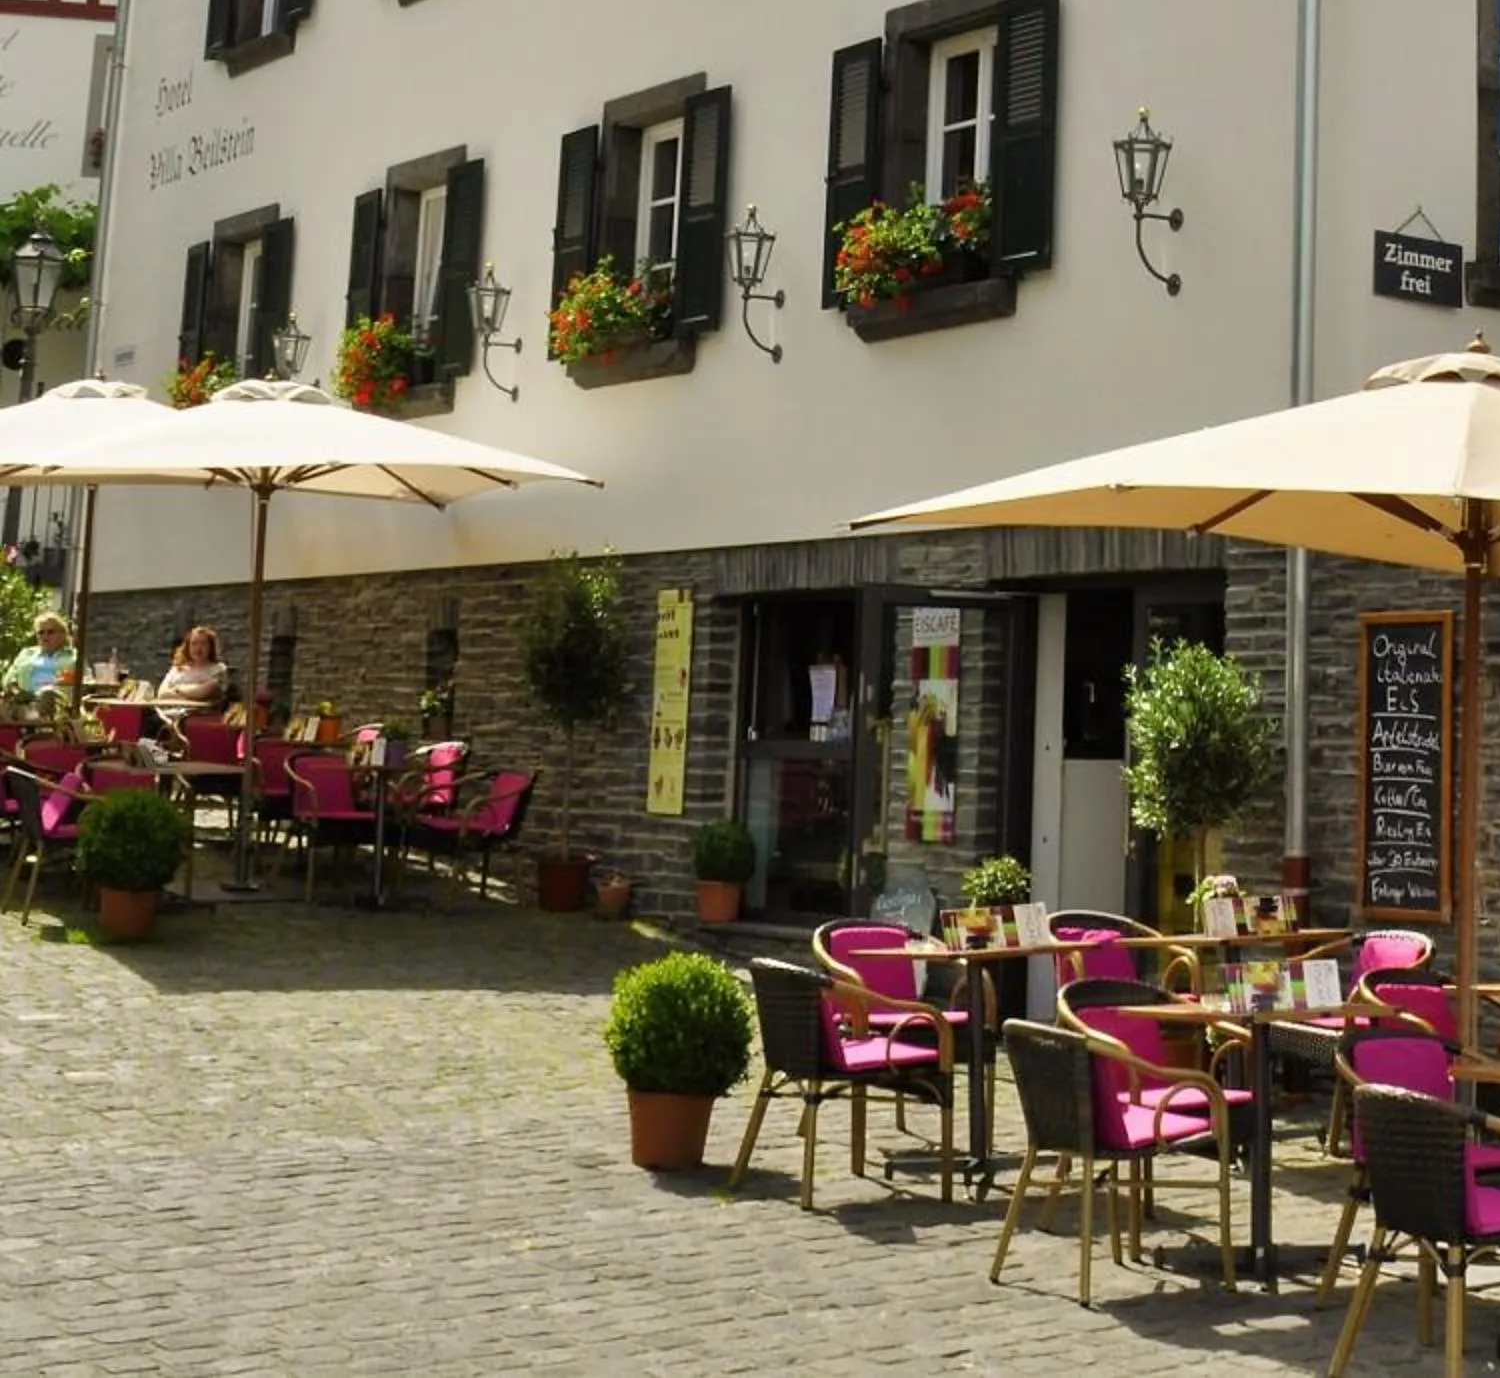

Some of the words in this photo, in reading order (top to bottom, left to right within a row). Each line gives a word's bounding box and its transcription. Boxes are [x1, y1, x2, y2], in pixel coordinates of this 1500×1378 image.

[154, 60, 194, 118] Hotel
[149, 144, 183, 190] Villa
[187, 116, 256, 176] Beilstein
[1384, 242, 1453, 273] Zimmer
[1400, 270, 1432, 294] frei
[1373, 631, 1437, 667] Original
